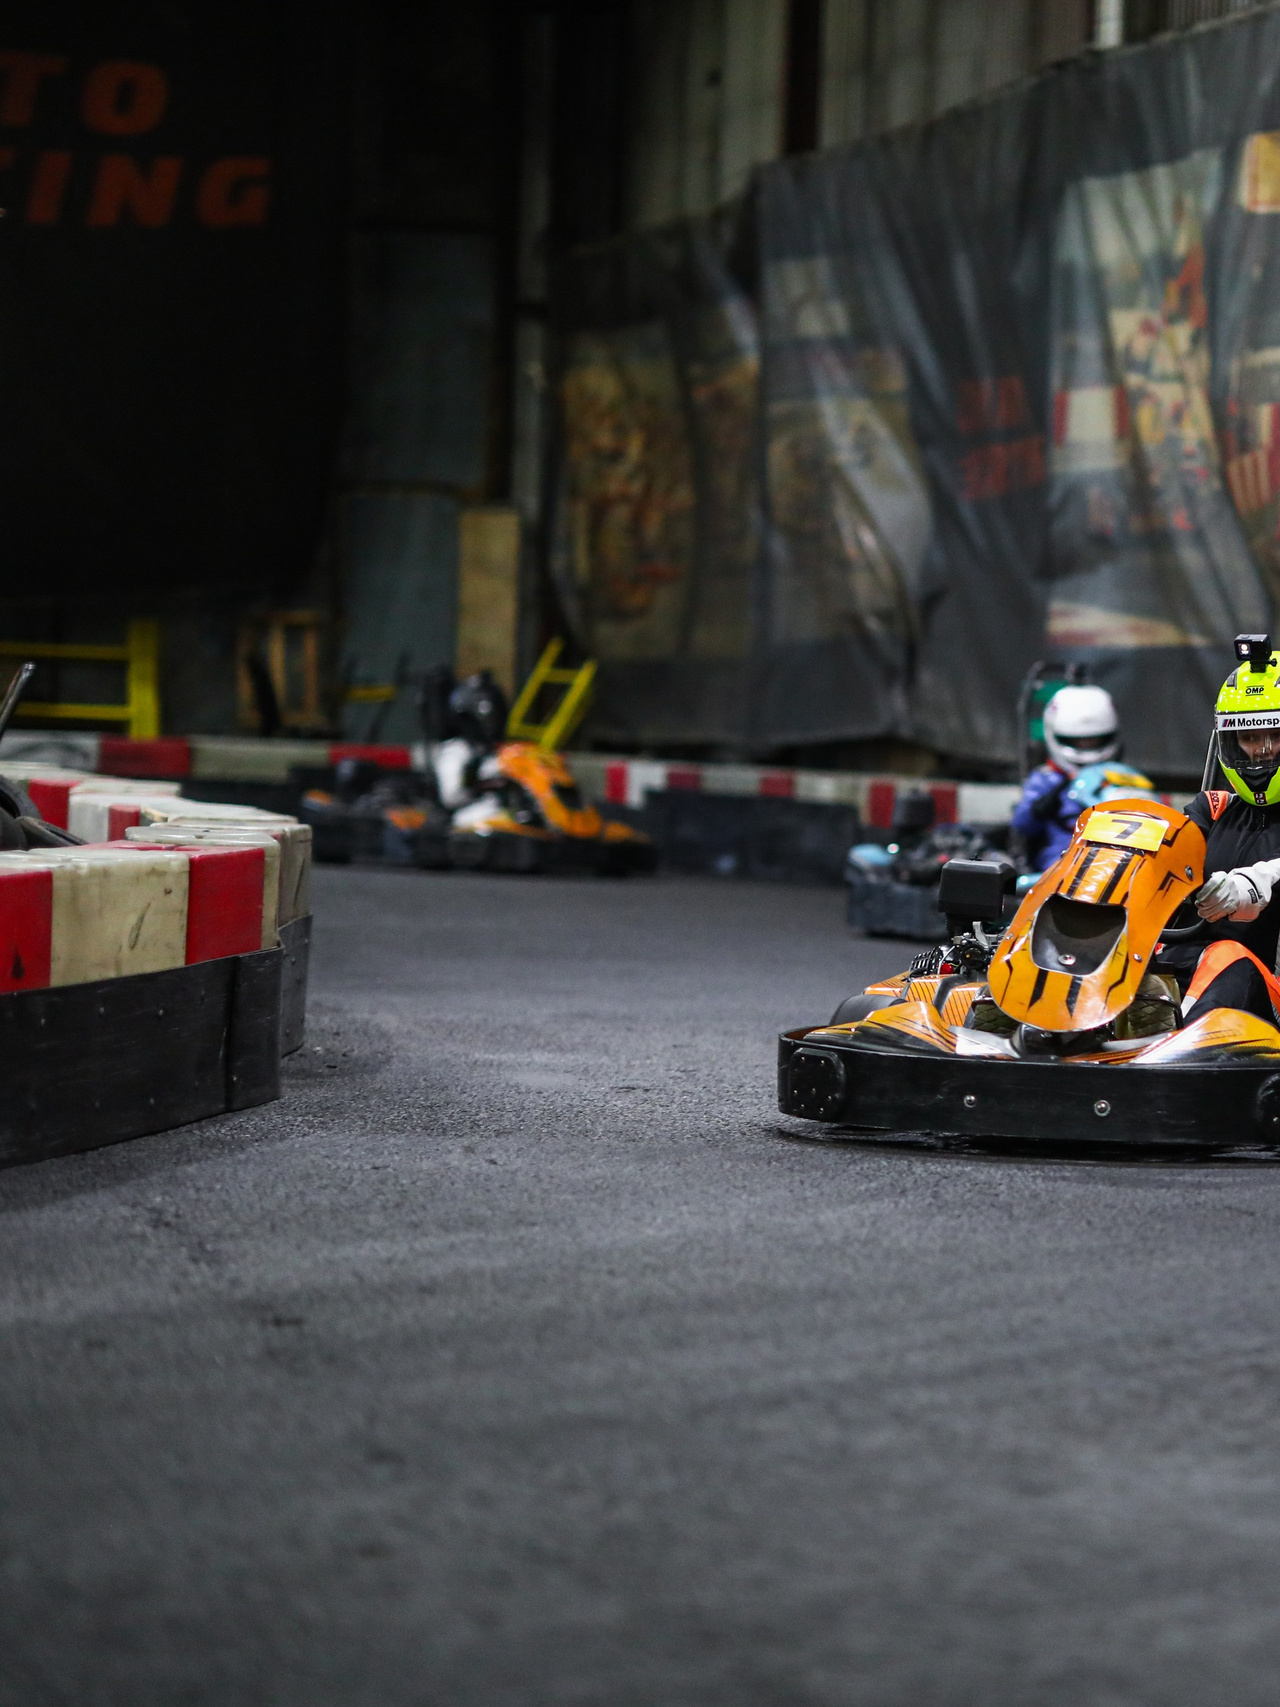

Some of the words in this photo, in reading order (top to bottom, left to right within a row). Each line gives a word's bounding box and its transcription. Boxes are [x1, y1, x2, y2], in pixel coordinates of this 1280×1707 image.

[0, 50, 168, 136] TO
[0, 146, 271, 227] ING
[1245, 687, 1265, 695] OMP
[1112, 819, 1142, 839] 7
